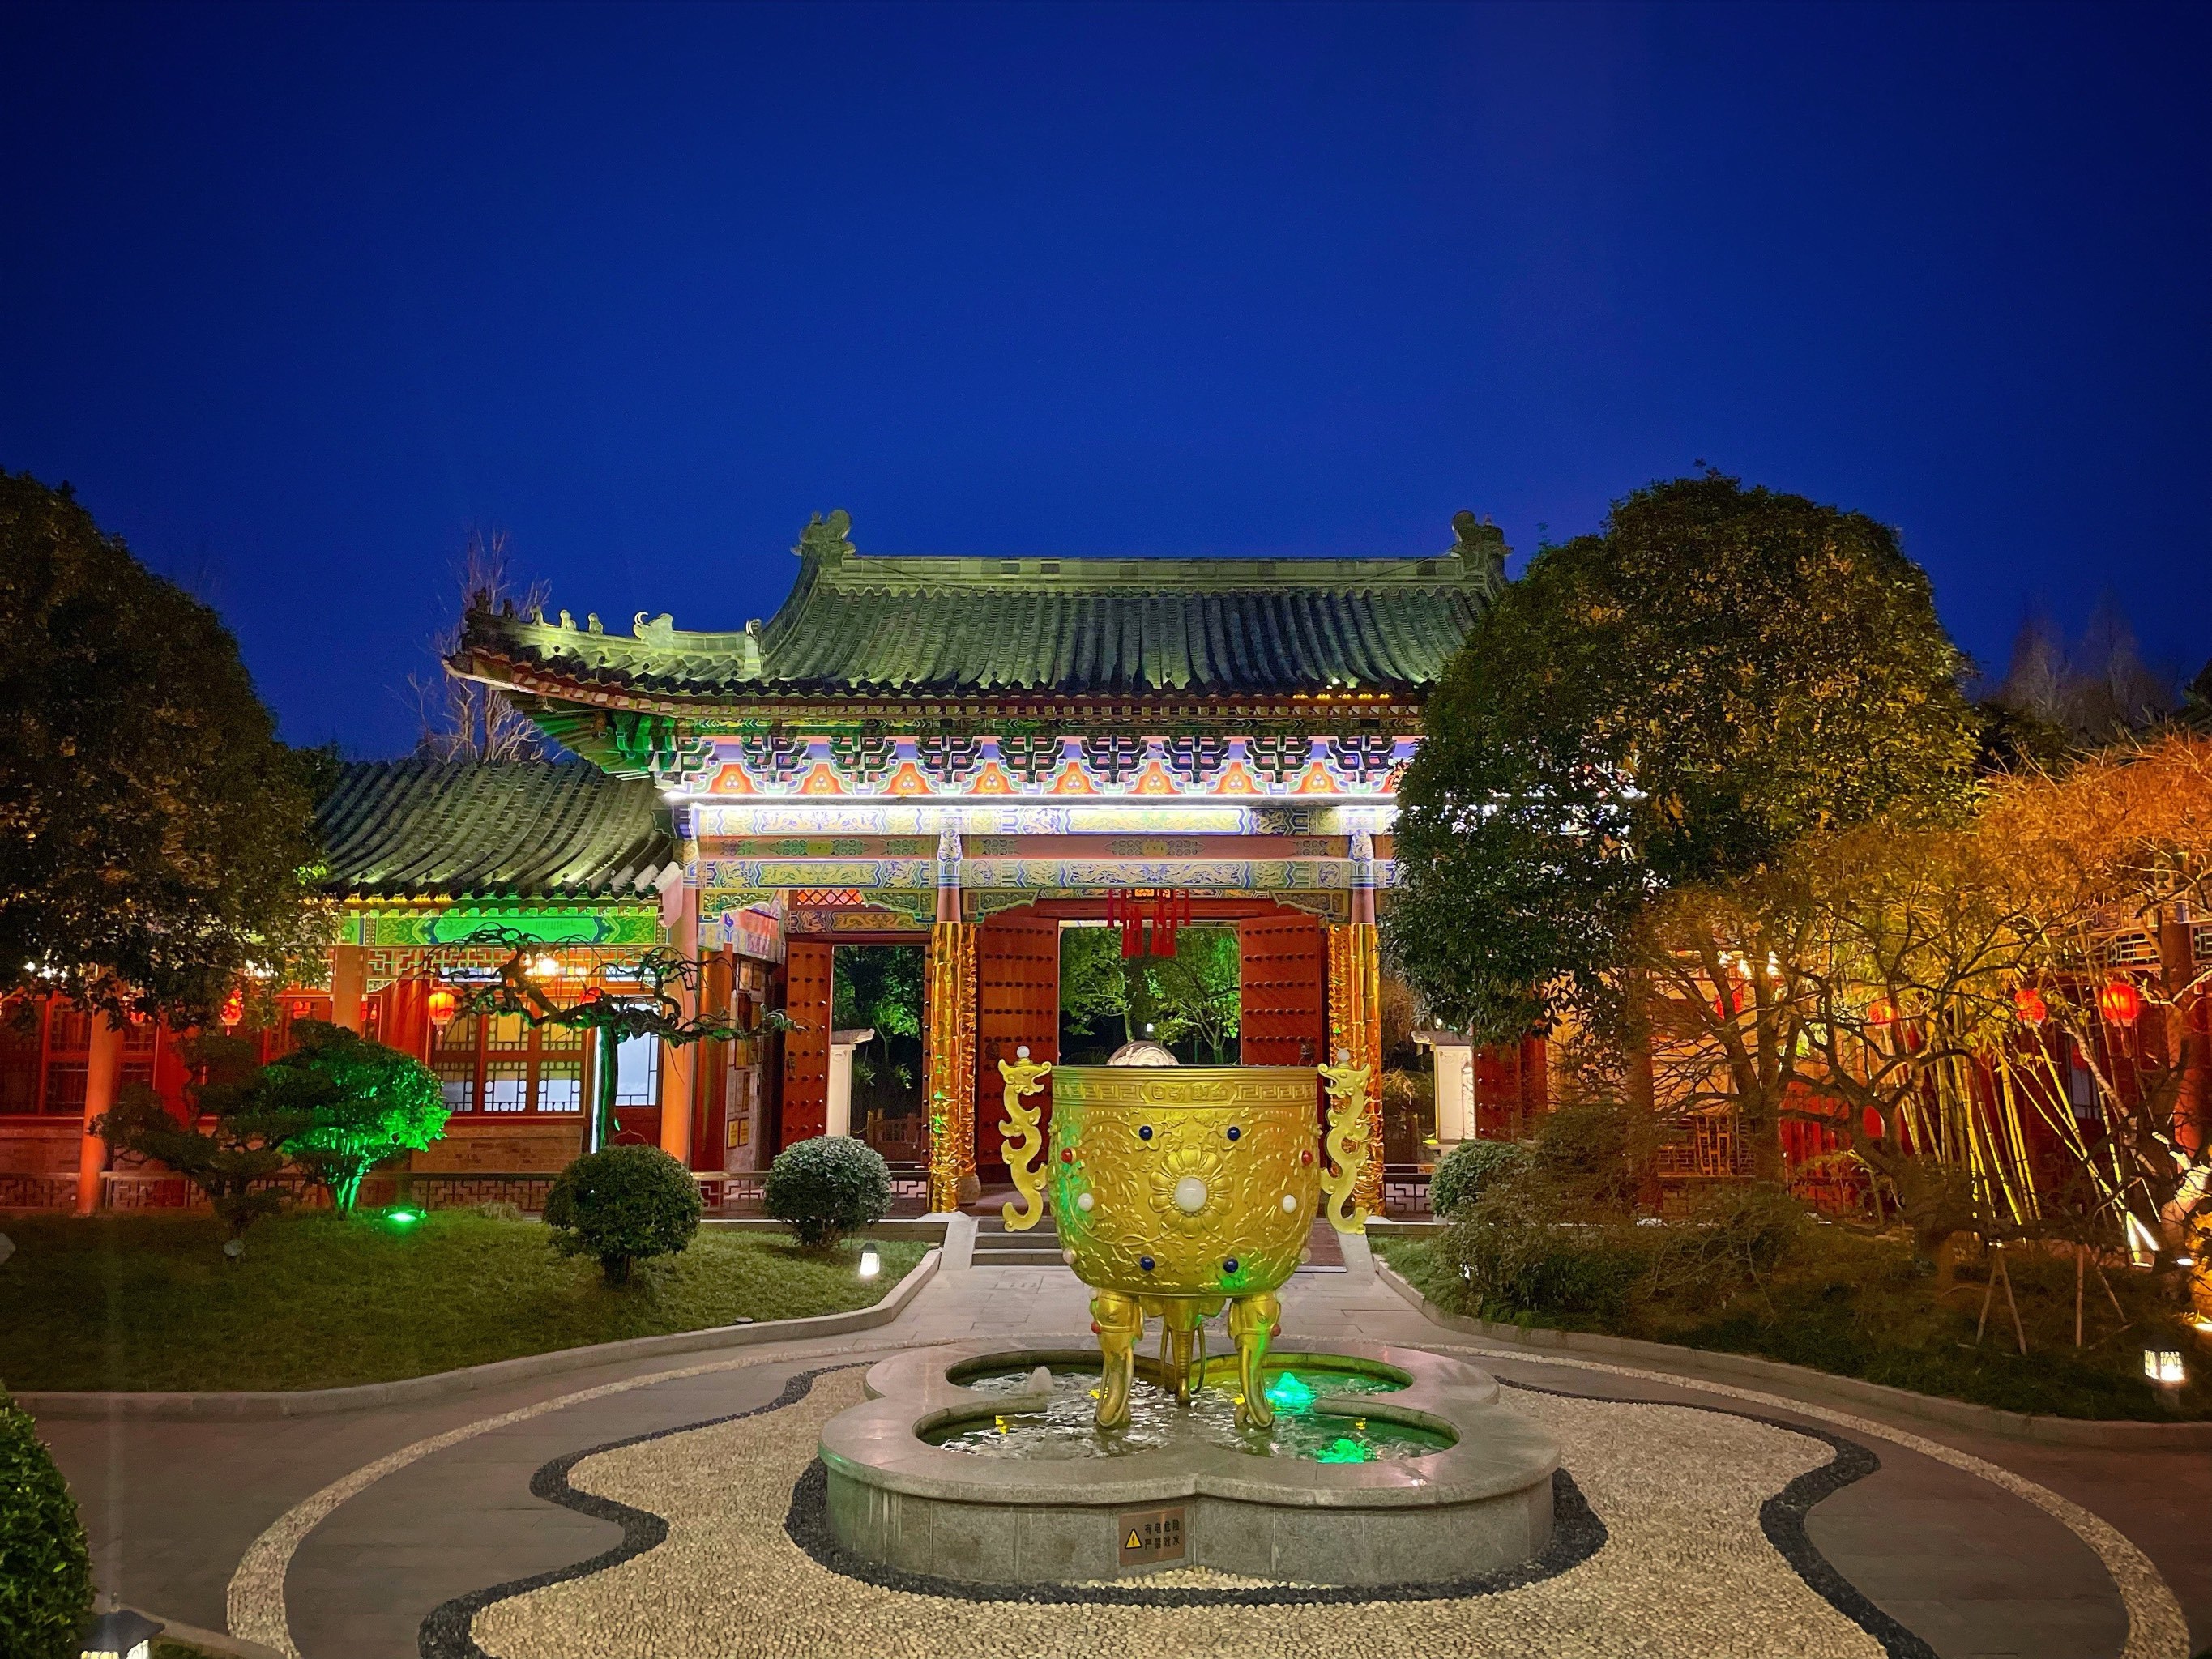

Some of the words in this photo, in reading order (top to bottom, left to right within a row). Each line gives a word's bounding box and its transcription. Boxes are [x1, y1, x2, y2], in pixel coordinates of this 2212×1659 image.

[1145, 1520, 1180, 1534] 有电危险
[1145, 1535, 1180, 1550] 严禁戏水
